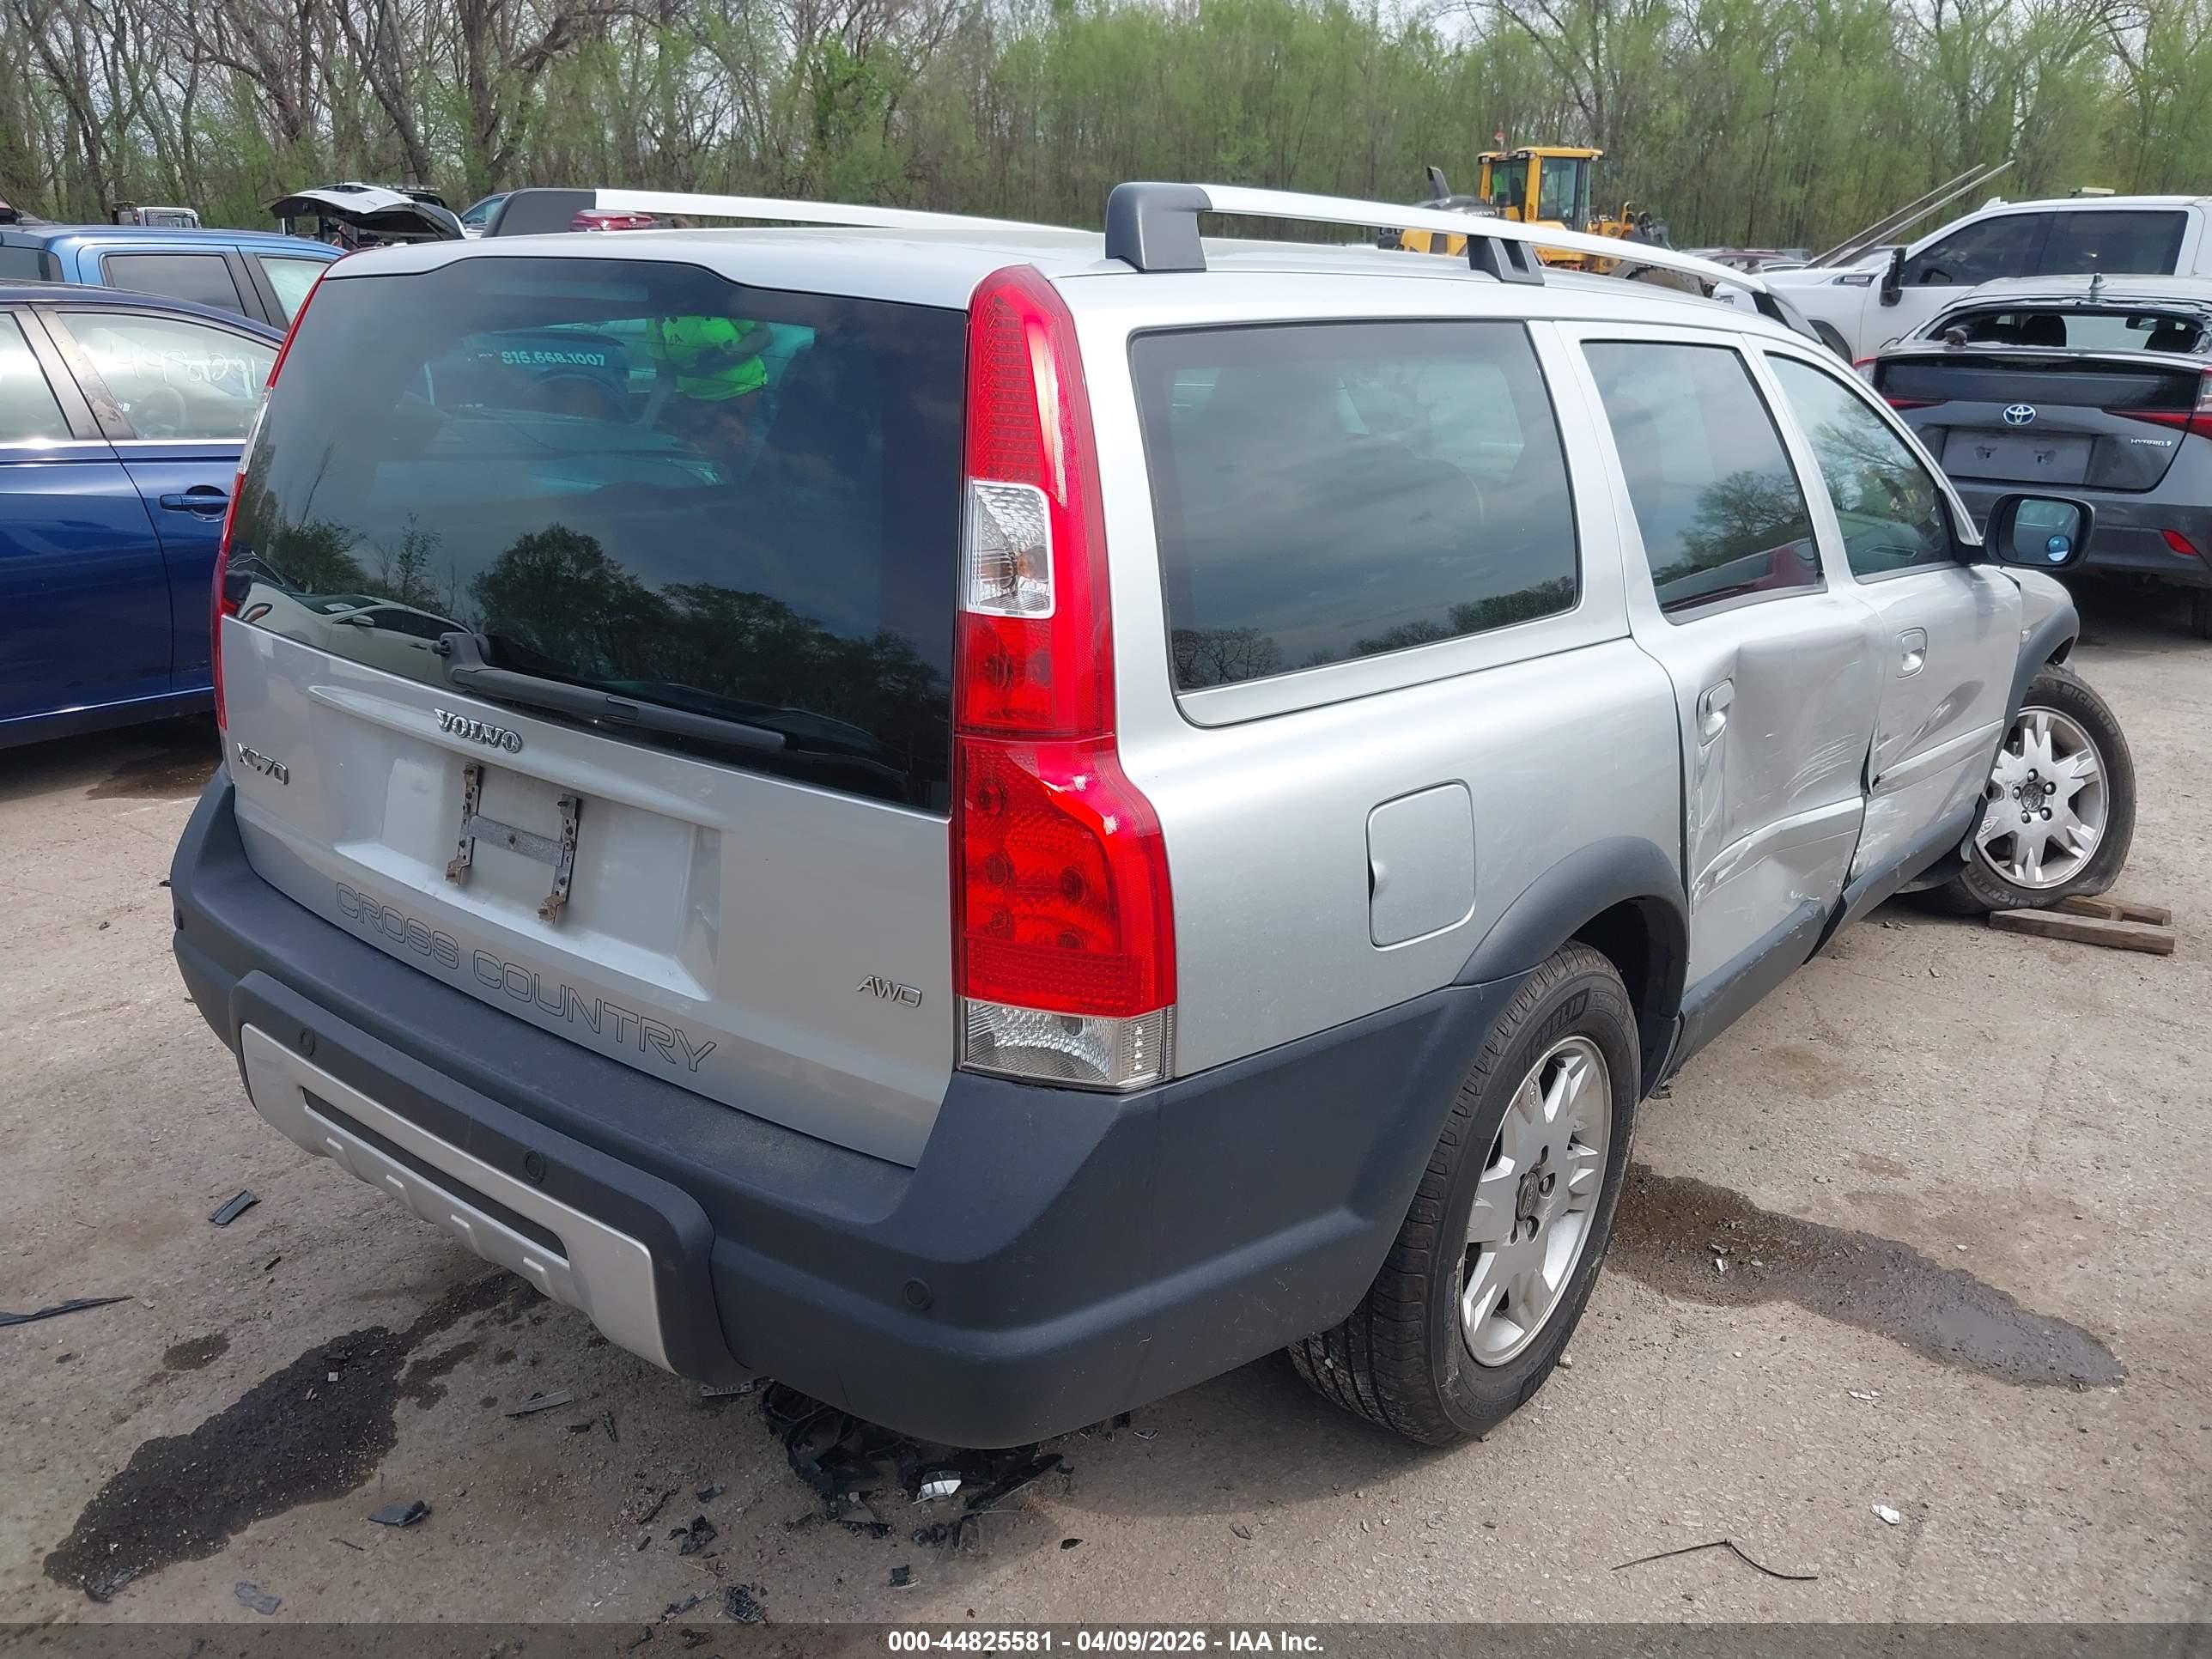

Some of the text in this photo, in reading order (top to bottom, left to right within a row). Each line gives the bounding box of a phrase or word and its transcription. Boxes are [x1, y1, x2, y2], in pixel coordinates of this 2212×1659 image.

[433, 707, 523, 754] VOLVO
[336, 881, 717, 1073] CROSS COUNTRY
[857, 975, 922, 1008] AWD
